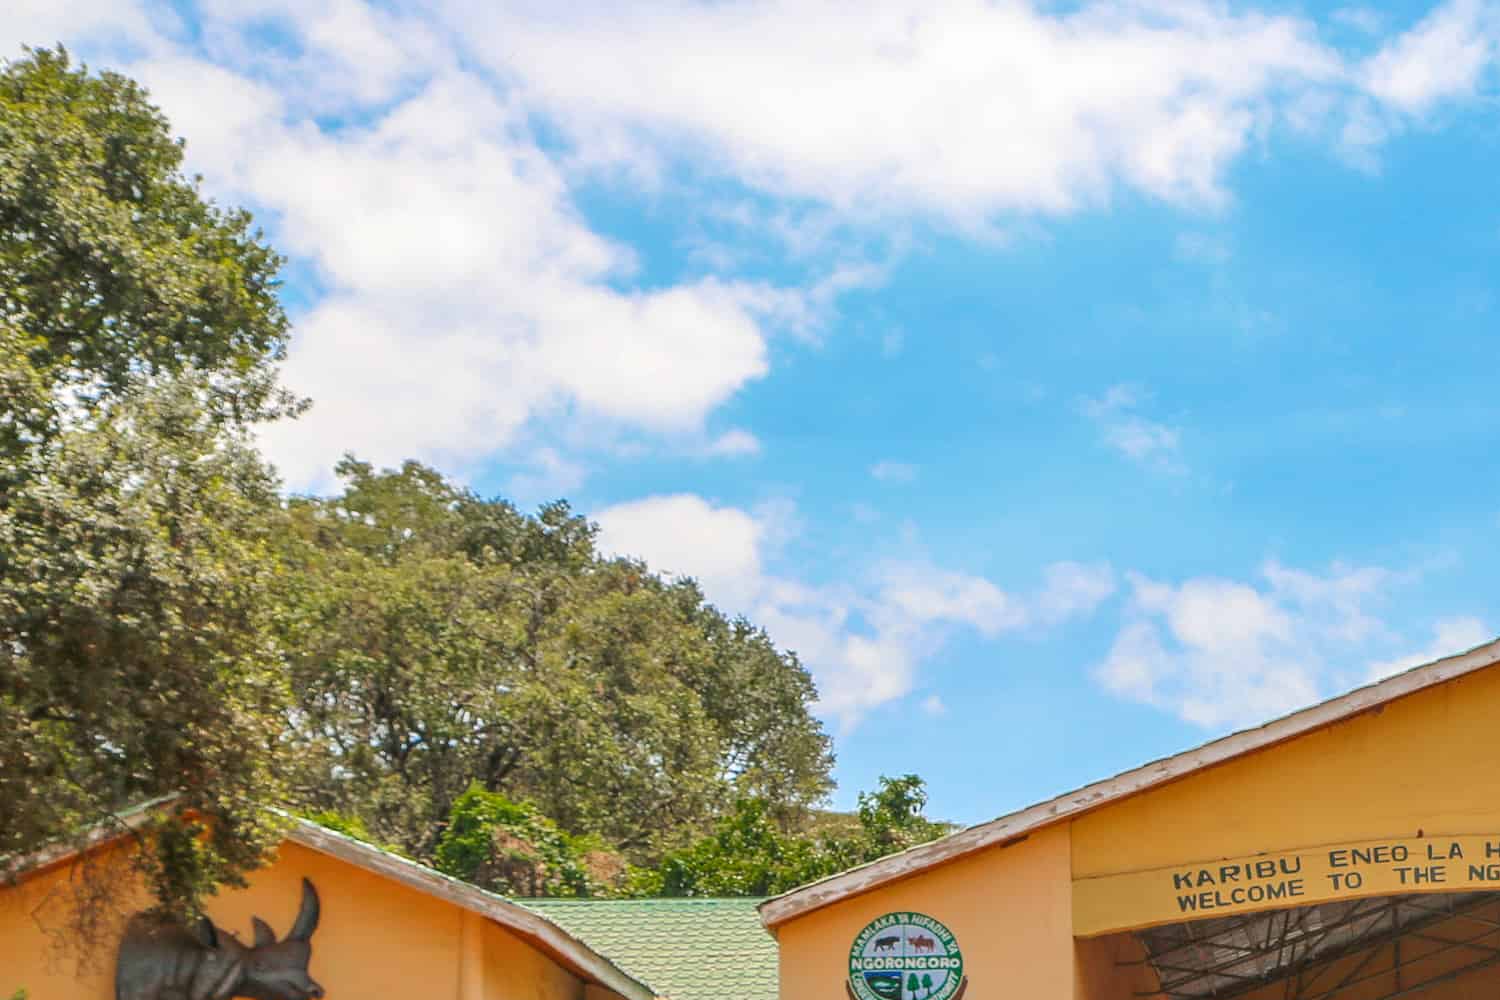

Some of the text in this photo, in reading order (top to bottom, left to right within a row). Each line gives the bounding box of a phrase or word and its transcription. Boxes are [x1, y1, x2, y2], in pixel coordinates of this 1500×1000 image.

[1173, 856, 1301, 889] KARIBU
[1329, 845, 1408, 868] ENEO
[1427, 843, 1464, 860] LA
[1177, 879, 1305, 912] WELCOME
[1328, 872, 1362, 890] TO
[1393, 867, 1446, 884] THE
[852, 914, 959, 957] MAMLAKA YA HIFADHI YA
[851, 958, 960, 969] NGORONGORO
